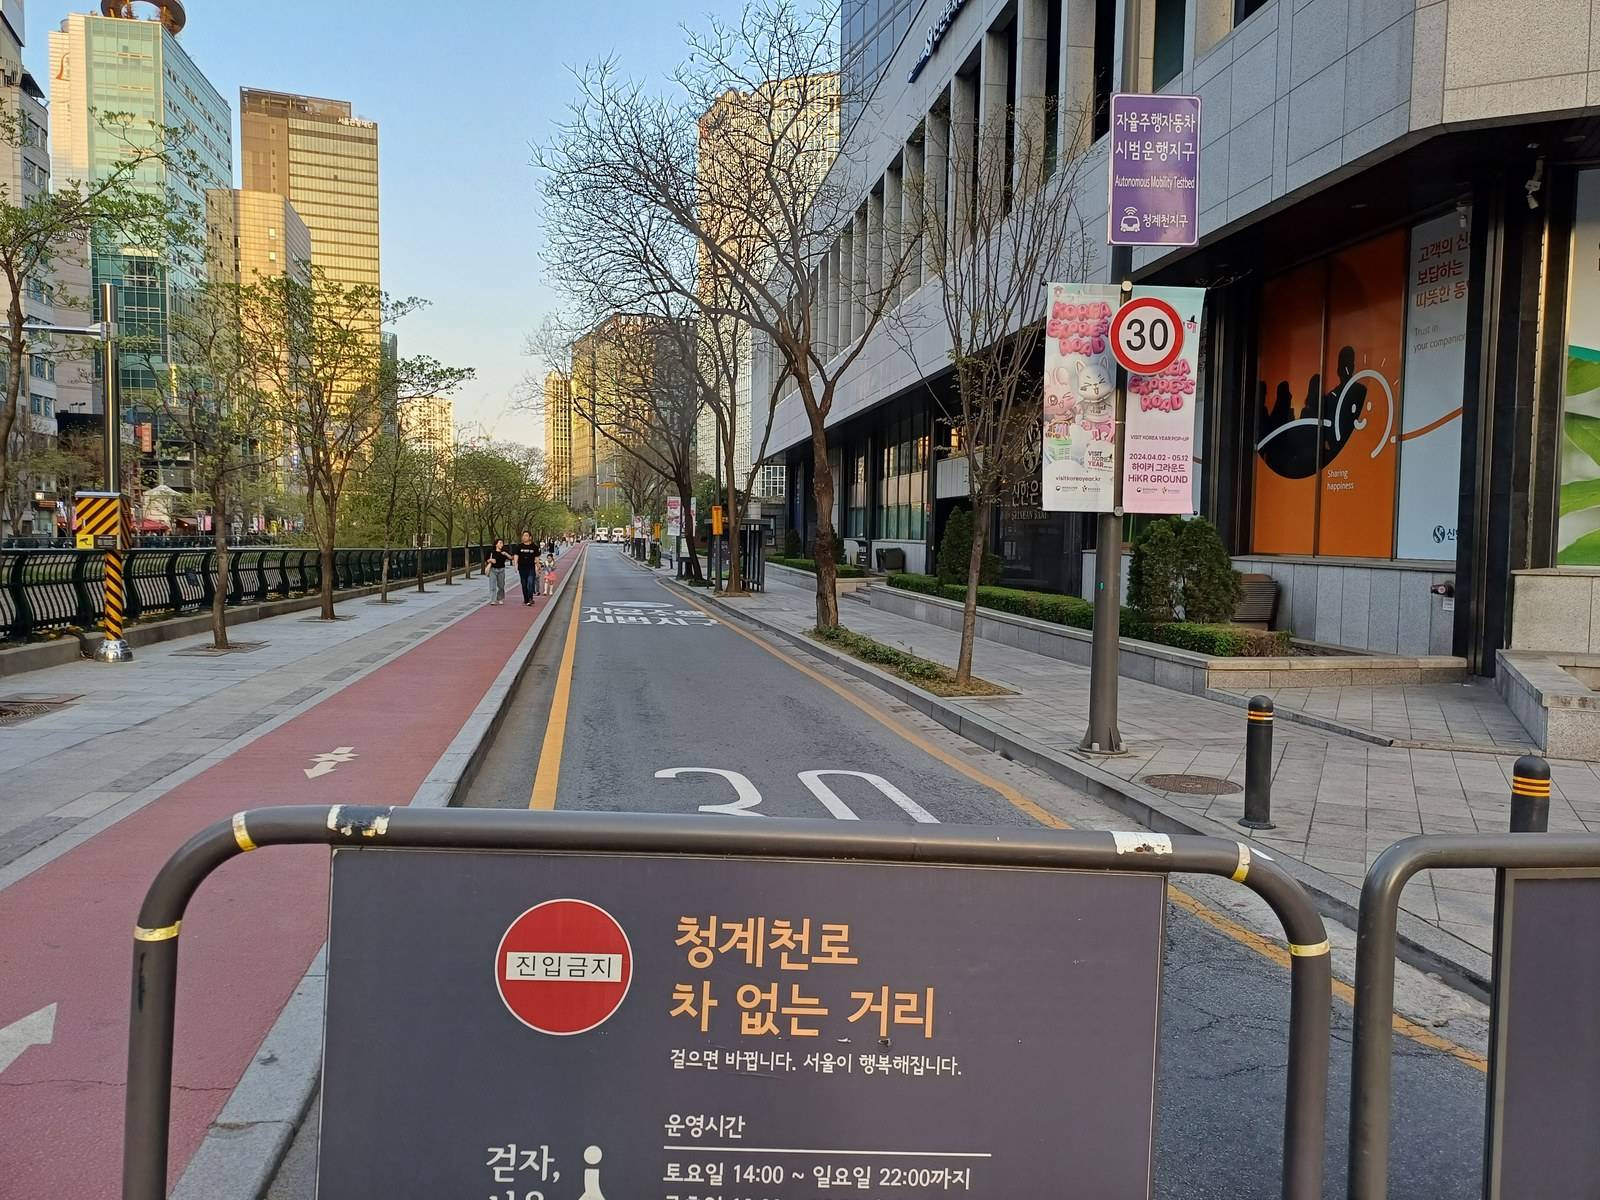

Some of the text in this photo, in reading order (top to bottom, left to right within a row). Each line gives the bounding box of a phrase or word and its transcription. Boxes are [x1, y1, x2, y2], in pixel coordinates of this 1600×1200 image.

[1116, 111, 1196, 134] 자율주행자동차
[1115, 140, 1195, 161] 시범운행지구
[1115, 175, 1195, 190] Autonomous Mobility Testbed
[1142, 213, 1188, 228] 청계천지구
[1418, 231, 1471, 263] 고객의 신
[1416, 259, 1464, 286] 보답하는
[1416, 280, 1470, 308] 따뜻한 동
[1126, 318, 1168, 352] 30
[1415, 325, 1430, 336] Trust
[1413, 342, 1428, 353] your
[1141, 394, 1183, 413] ROAD
[1129, 453, 1167, 461] 2024.04.02
[1131, 462, 1185, 473] 하이커 그라운드
[1128, 474, 1188, 484] HiKR GROUND
[1327, 470, 1348, 480] Sharing
[1011, 479, 1042, 508] 신한은
[1327, 482, 1354, 492] happiness
[674, 915, 859, 971] 청계천로
[516, 955, 612, 978] 진입금지
[669, 980, 934, 1039] 차 없는 거리
[670, 1048, 962, 1076] 걸으면 바뀝니다. 서울이 행복해집니다.
[664, 1113, 746, 1139] 운영시간
[485, 1143, 561, 1183] 걷자,
[662, 1161, 724, 1187] 토요일
[733, 1163, 784, 1184] 14:00
[812, 1164, 871, 1190] 일요일
[879, 1166, 970, 1190] 22:00까지
